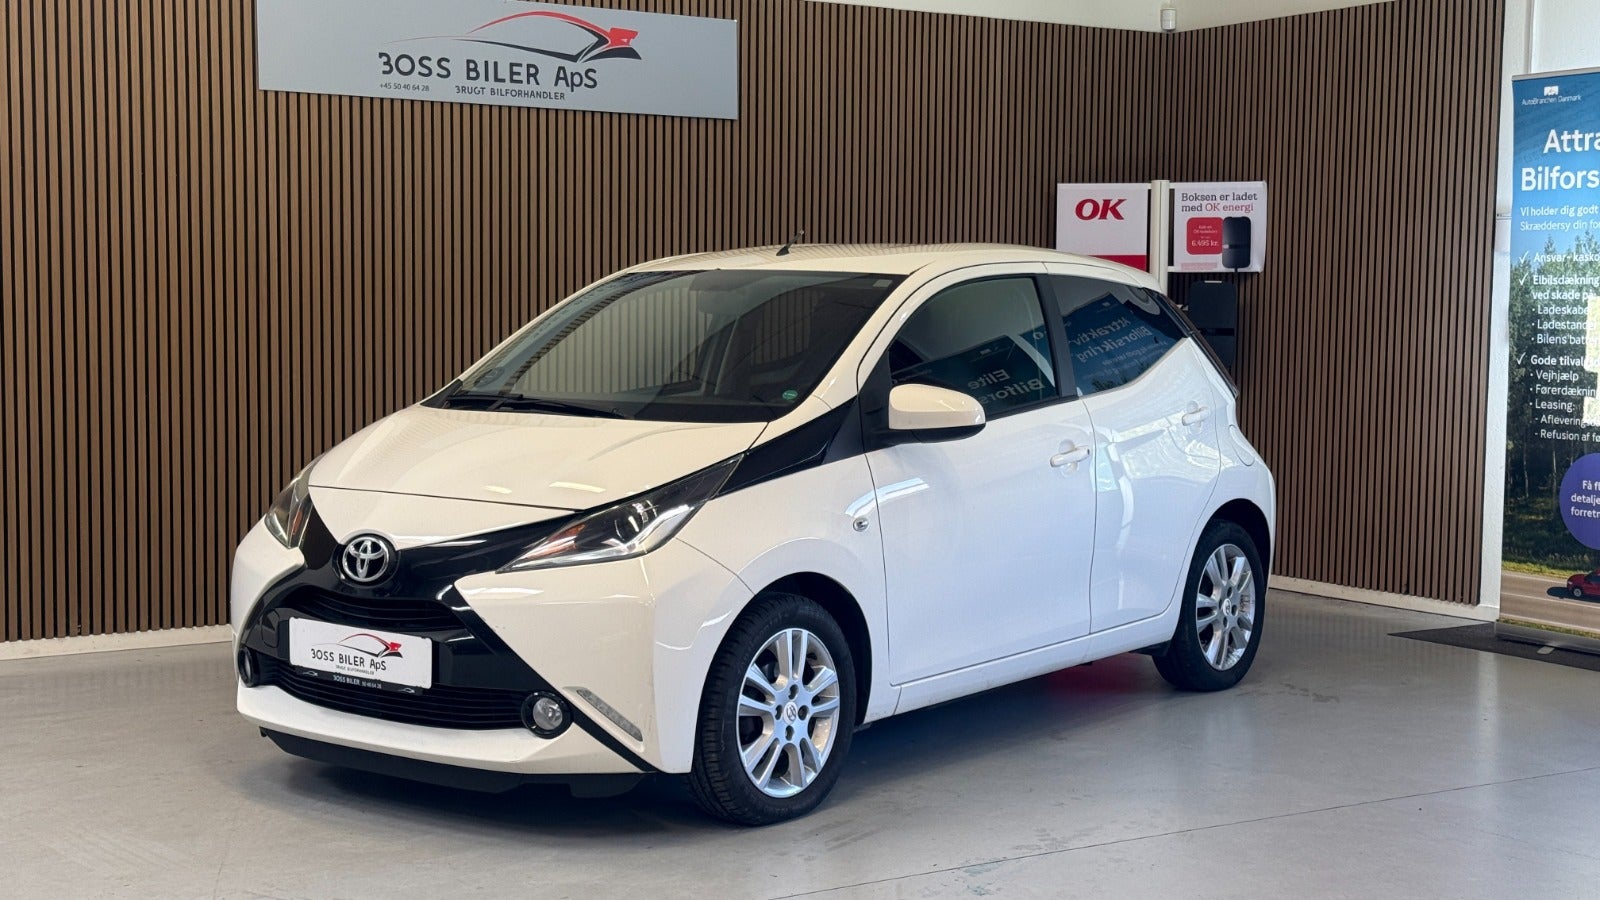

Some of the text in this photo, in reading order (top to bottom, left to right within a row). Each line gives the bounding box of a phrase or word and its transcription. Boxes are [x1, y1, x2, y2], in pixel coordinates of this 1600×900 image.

[466, 59, 540, 86] BILER
[554, 65, 598, 93] ApS
[380, 82, 392, 90] +45
[402, 83, 411, 91] 40
[421, 84, 430, 92] 28
[490, 88, 566, 100] BILFORHANDLER
[1521, 94, 1582, 106] AutoBranchen Danmark
[1181, 191, 1258, 202] Boksen er ladet
[1075, 198, 1127, 221] OK
[1181, 202, 1254, 214] med OK energi
[1520, 203, 1599, 217] Vi holder dig godt
[1520, 219, 1571, 232] Skræddersy
[1573, 219, 1587, 230] din
[1533, 274, 1600, 287] Elbilsdækning
[1532, 289, 1550, 300] ved
[1551, 289, 1580, 300] skade
[1536, 333, 1568, 345] Bilens
[1530, 354, 1557, 366] Gode
[1535, 370, 1579, 383] Vejhjælp
[1535, 398, 1576, 413] Leasing:
[1540, 429, 1580, 441] Refusion
[1581, 432, 1591, 442] af
[1582, 479, 1593, 491] Få
[338, 653, 365, 667] BILER
[369, 658, 387, 672] ApS
